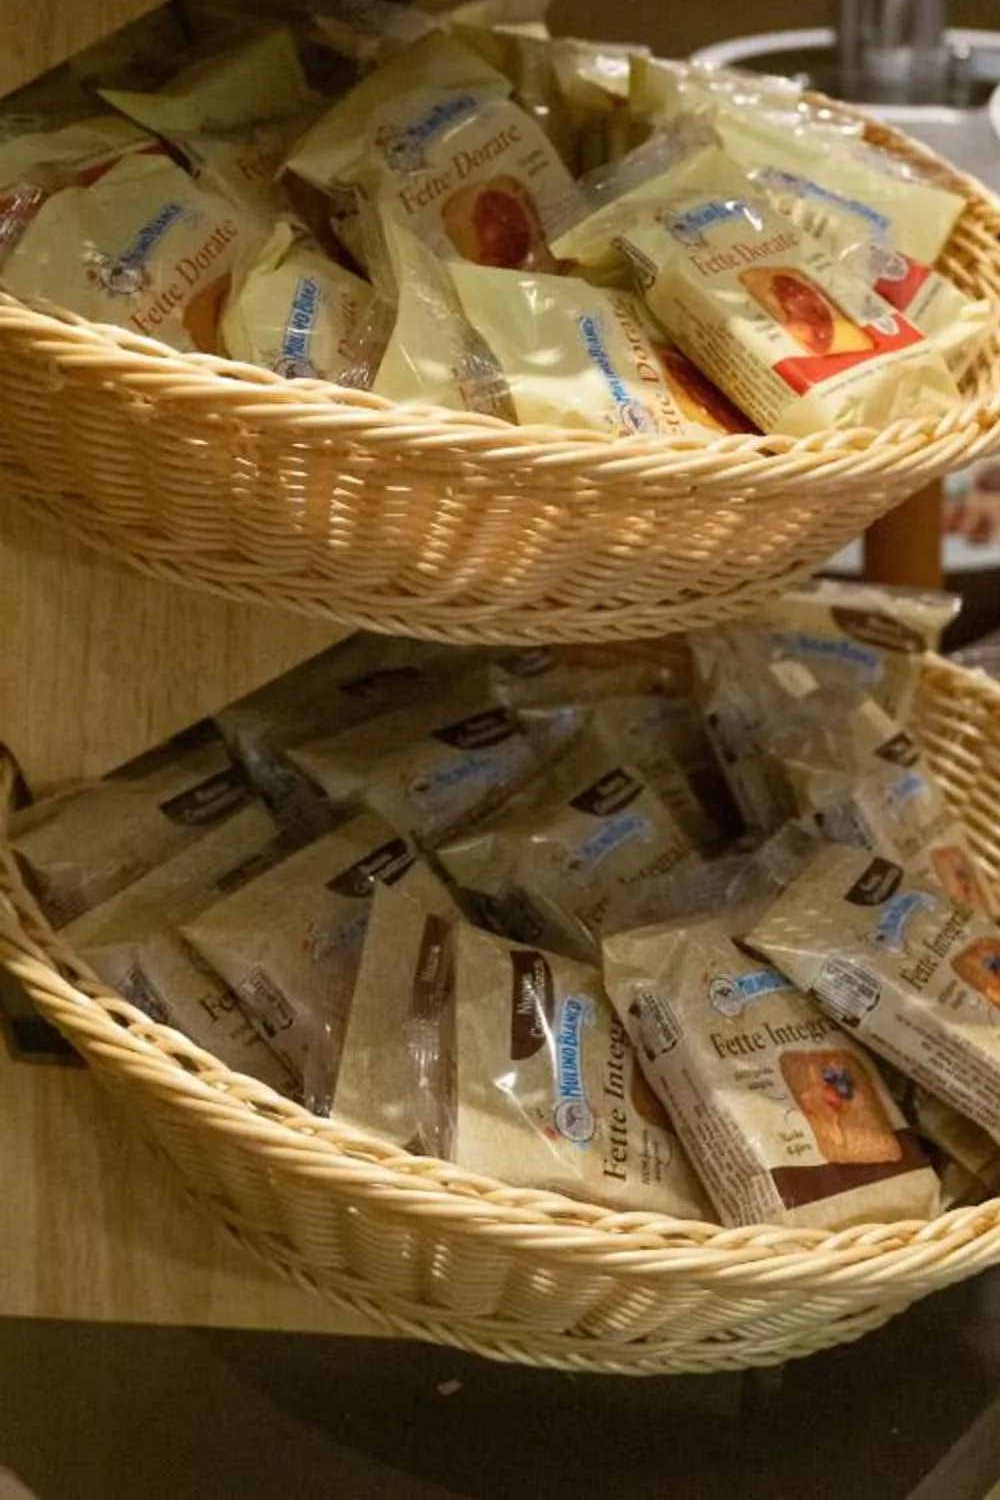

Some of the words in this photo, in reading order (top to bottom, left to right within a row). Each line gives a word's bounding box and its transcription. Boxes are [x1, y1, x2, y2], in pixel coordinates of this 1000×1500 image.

[175, 218, 240, 286] Dorate
[709, 1031, 766, 1060] Fette
[763, 1018, 842, 1049] Integra
[560, 1045, 581, 1098] MULINO
[603, 1108, 628, 1182] Fette
